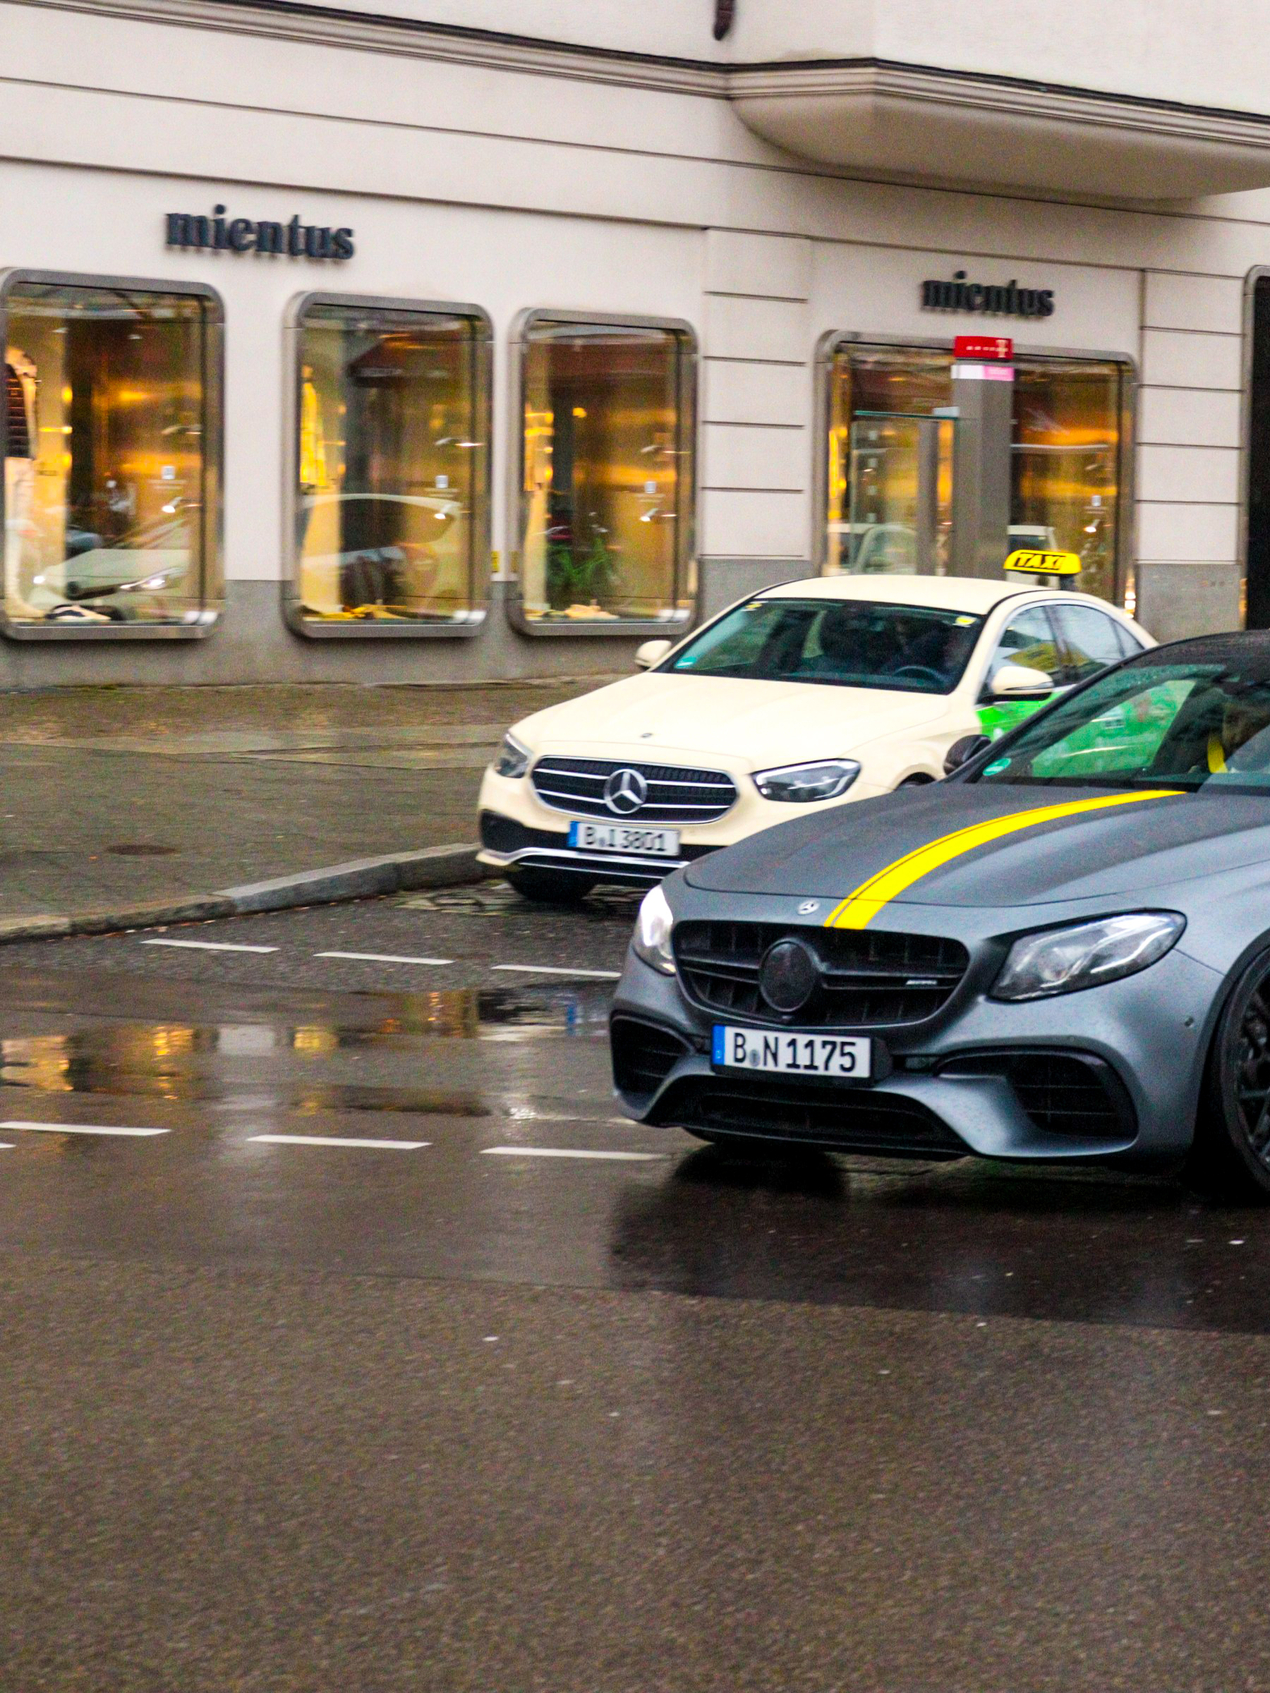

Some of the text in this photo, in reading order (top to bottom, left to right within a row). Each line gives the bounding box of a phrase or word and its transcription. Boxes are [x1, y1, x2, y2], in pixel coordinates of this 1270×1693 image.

[166, 203, 356, 260] mientus
[922, 270, 1055, 317] mientus
[1013, 551, 1067, 571] TAXI
[585, 826, 596, 846] B
[733, 1032, 747, 1064] B
[785, 1037, 857, 1073] 1175
